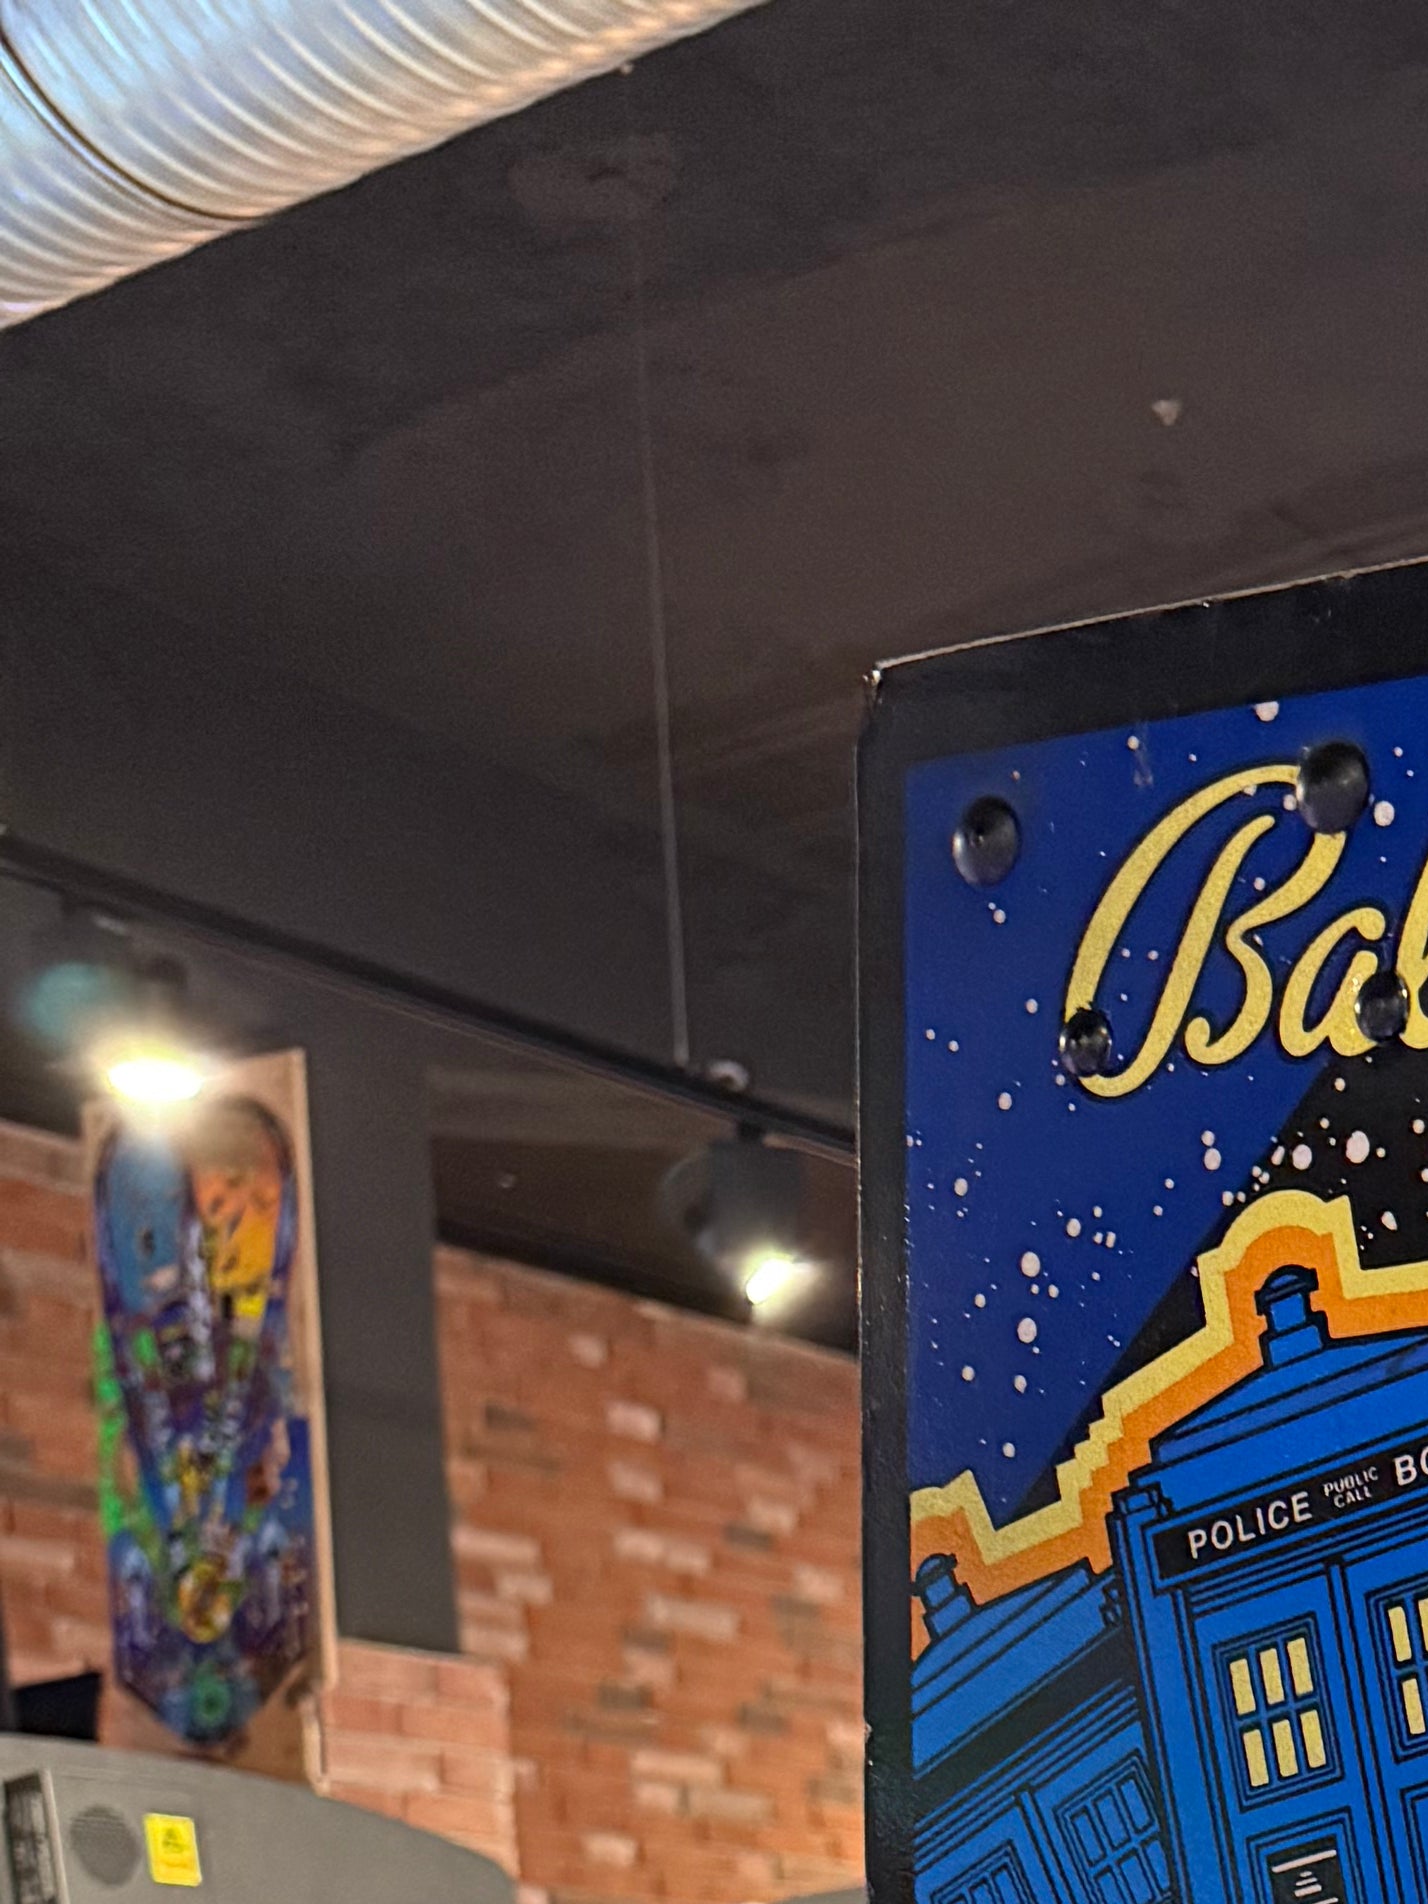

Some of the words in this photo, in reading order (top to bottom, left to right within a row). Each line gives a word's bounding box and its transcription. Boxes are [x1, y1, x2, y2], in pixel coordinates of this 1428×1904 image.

[1323, 1466, 1380, 1497] PUBLIC
[1333, 1487, 1373, 1509] CALL
[1187, 1491, 1313, 1560] POLICE
